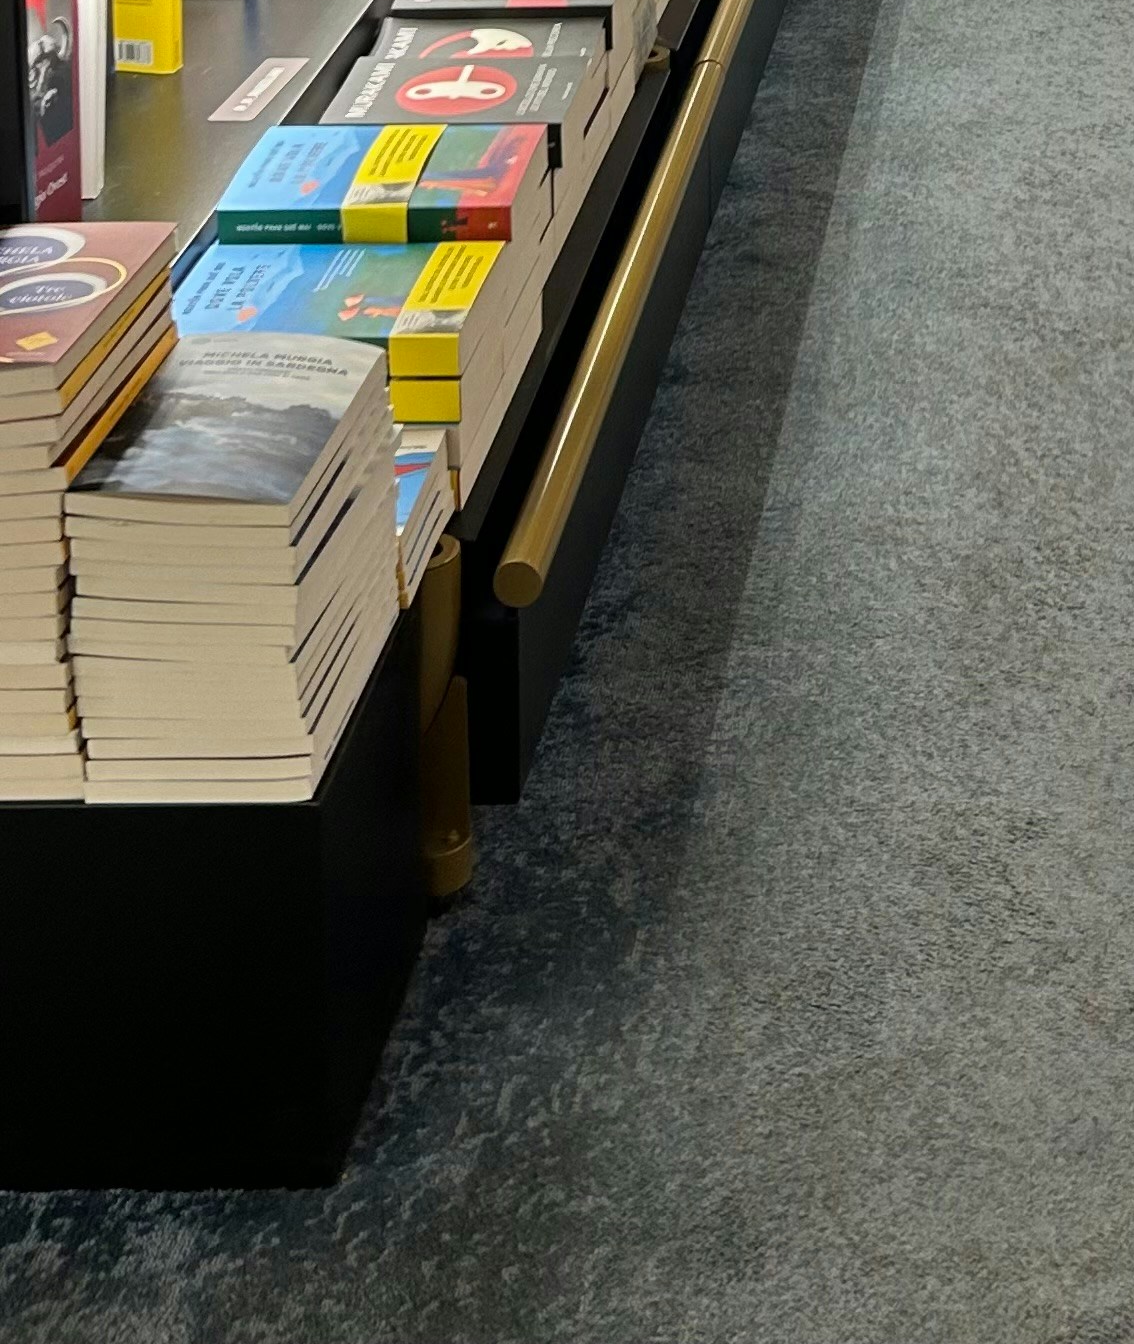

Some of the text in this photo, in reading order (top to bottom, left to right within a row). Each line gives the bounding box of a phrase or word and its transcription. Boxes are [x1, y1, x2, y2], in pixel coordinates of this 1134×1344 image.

[344, 62, 396, 118] MURAKAMI
[202, 351, 333, 365] MICHELA MURGIA
[178, 359, 349, 377] VIAGGIO IN SARDEGNA
